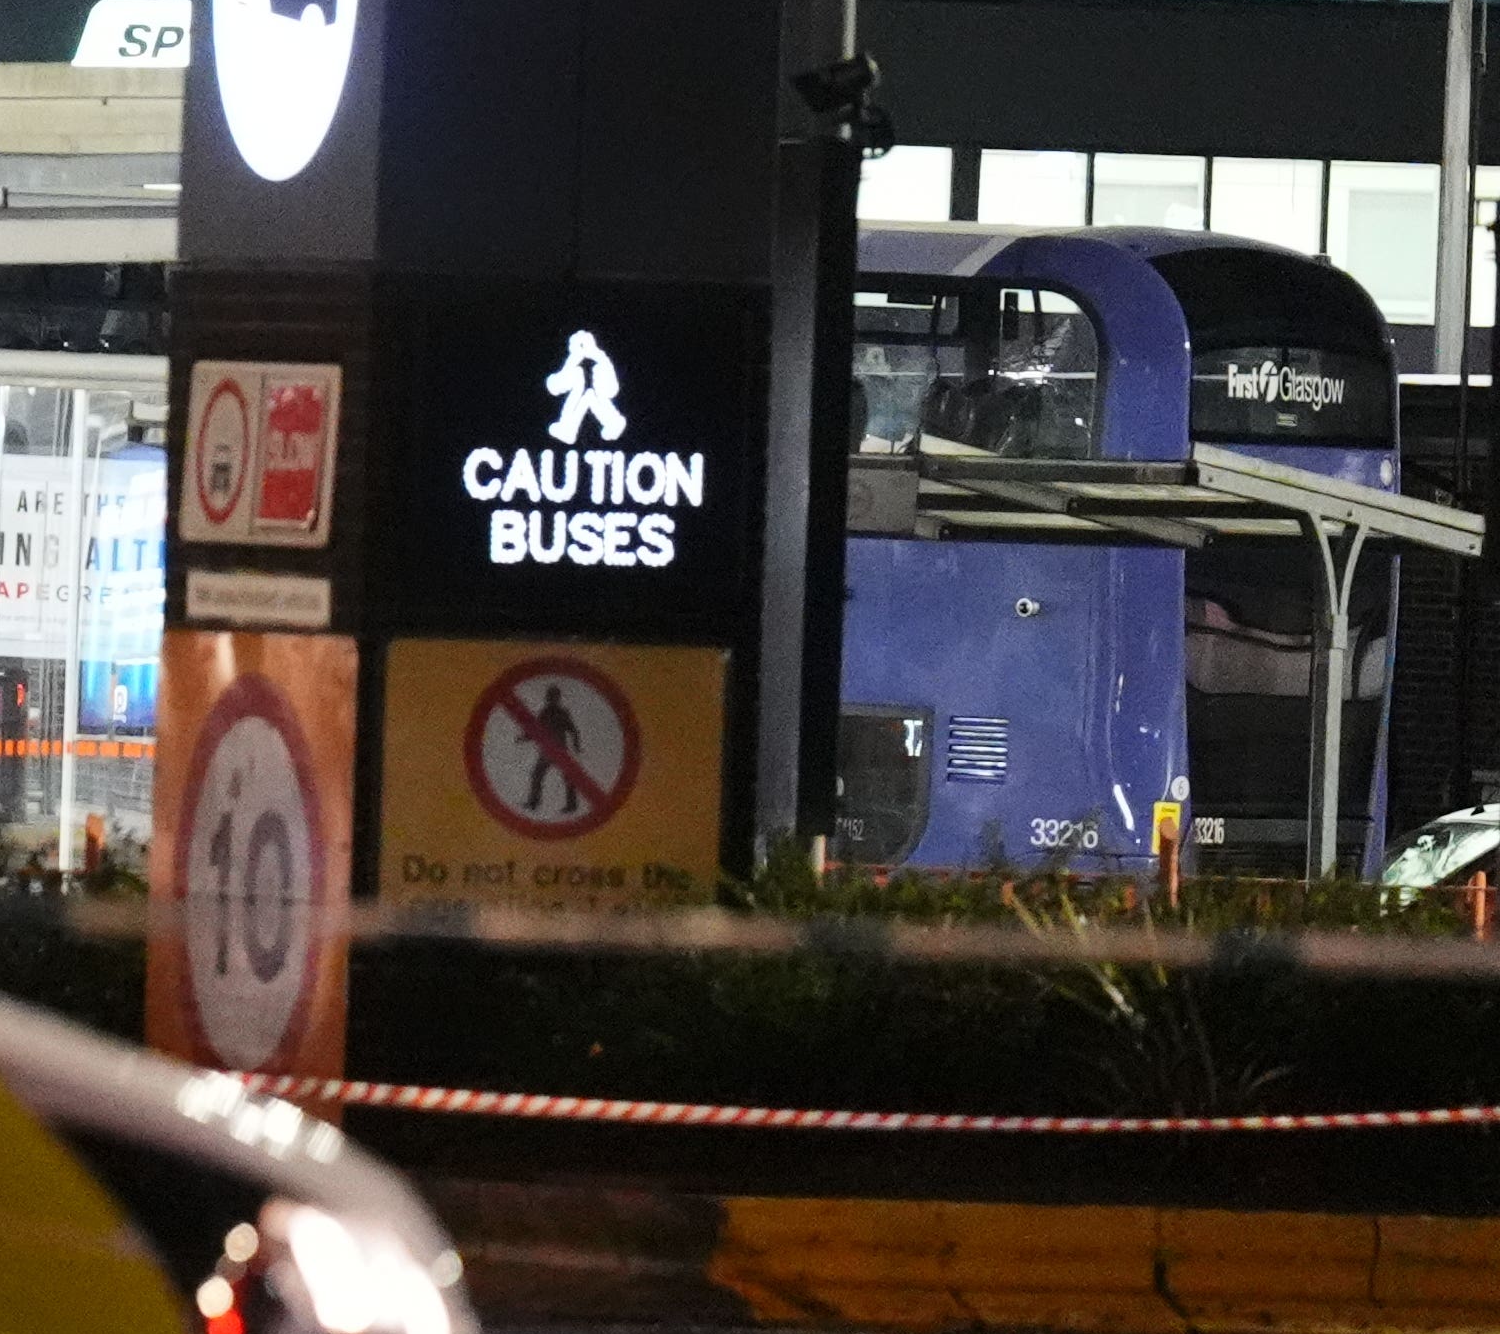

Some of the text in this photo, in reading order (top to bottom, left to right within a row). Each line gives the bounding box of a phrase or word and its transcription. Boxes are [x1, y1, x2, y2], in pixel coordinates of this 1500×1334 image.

[1226, 363, 1346, 412] First Glasgow
[16, 490, 64, 516] ARE
[463, 447, 704, 506] CAUTION
[490, 509, 675, 567] BUSES
[1194, 817, 1225, 845] 33216
[209, 810, 294, 985] 10
